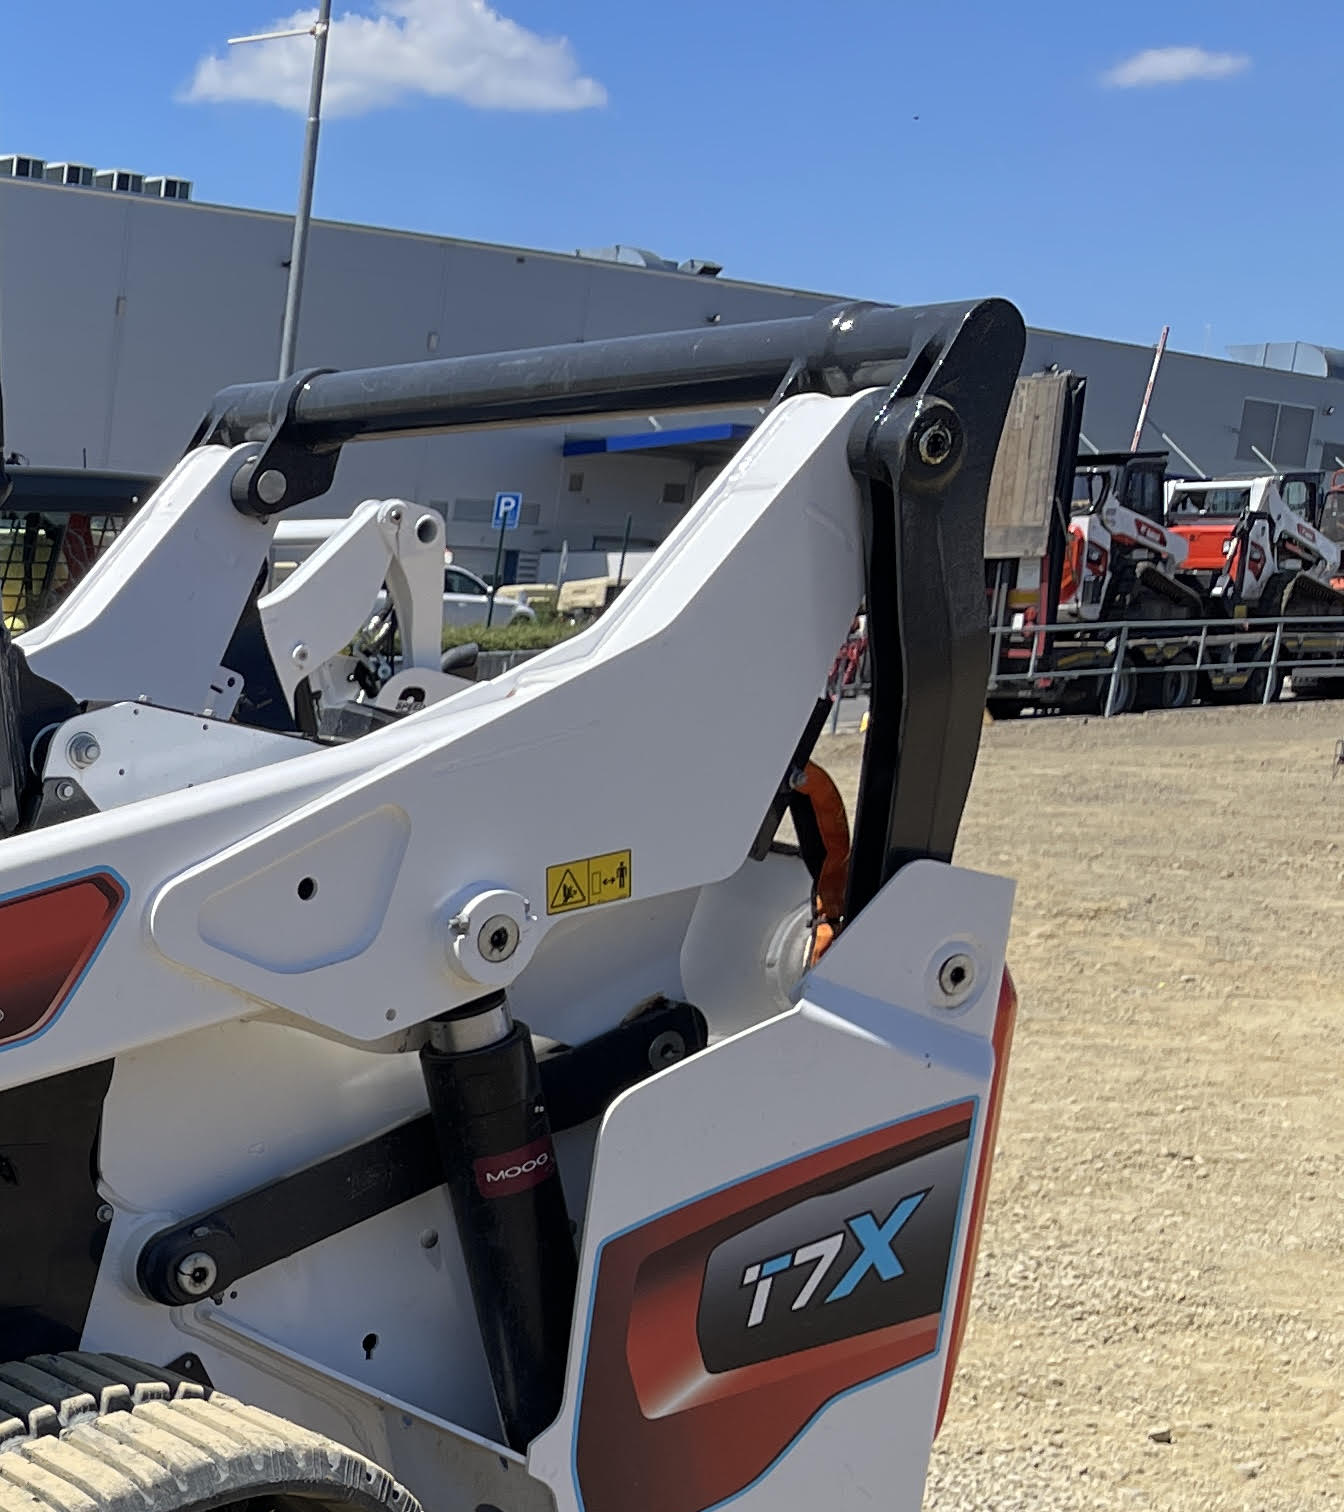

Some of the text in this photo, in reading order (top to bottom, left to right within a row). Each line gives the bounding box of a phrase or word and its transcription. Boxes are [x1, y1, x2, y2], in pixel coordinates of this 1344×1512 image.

[498, 496, 517, 518] P
[486, 1152, 549, 1183] MOOG
[739, 1184, 935, 1329] T7X
